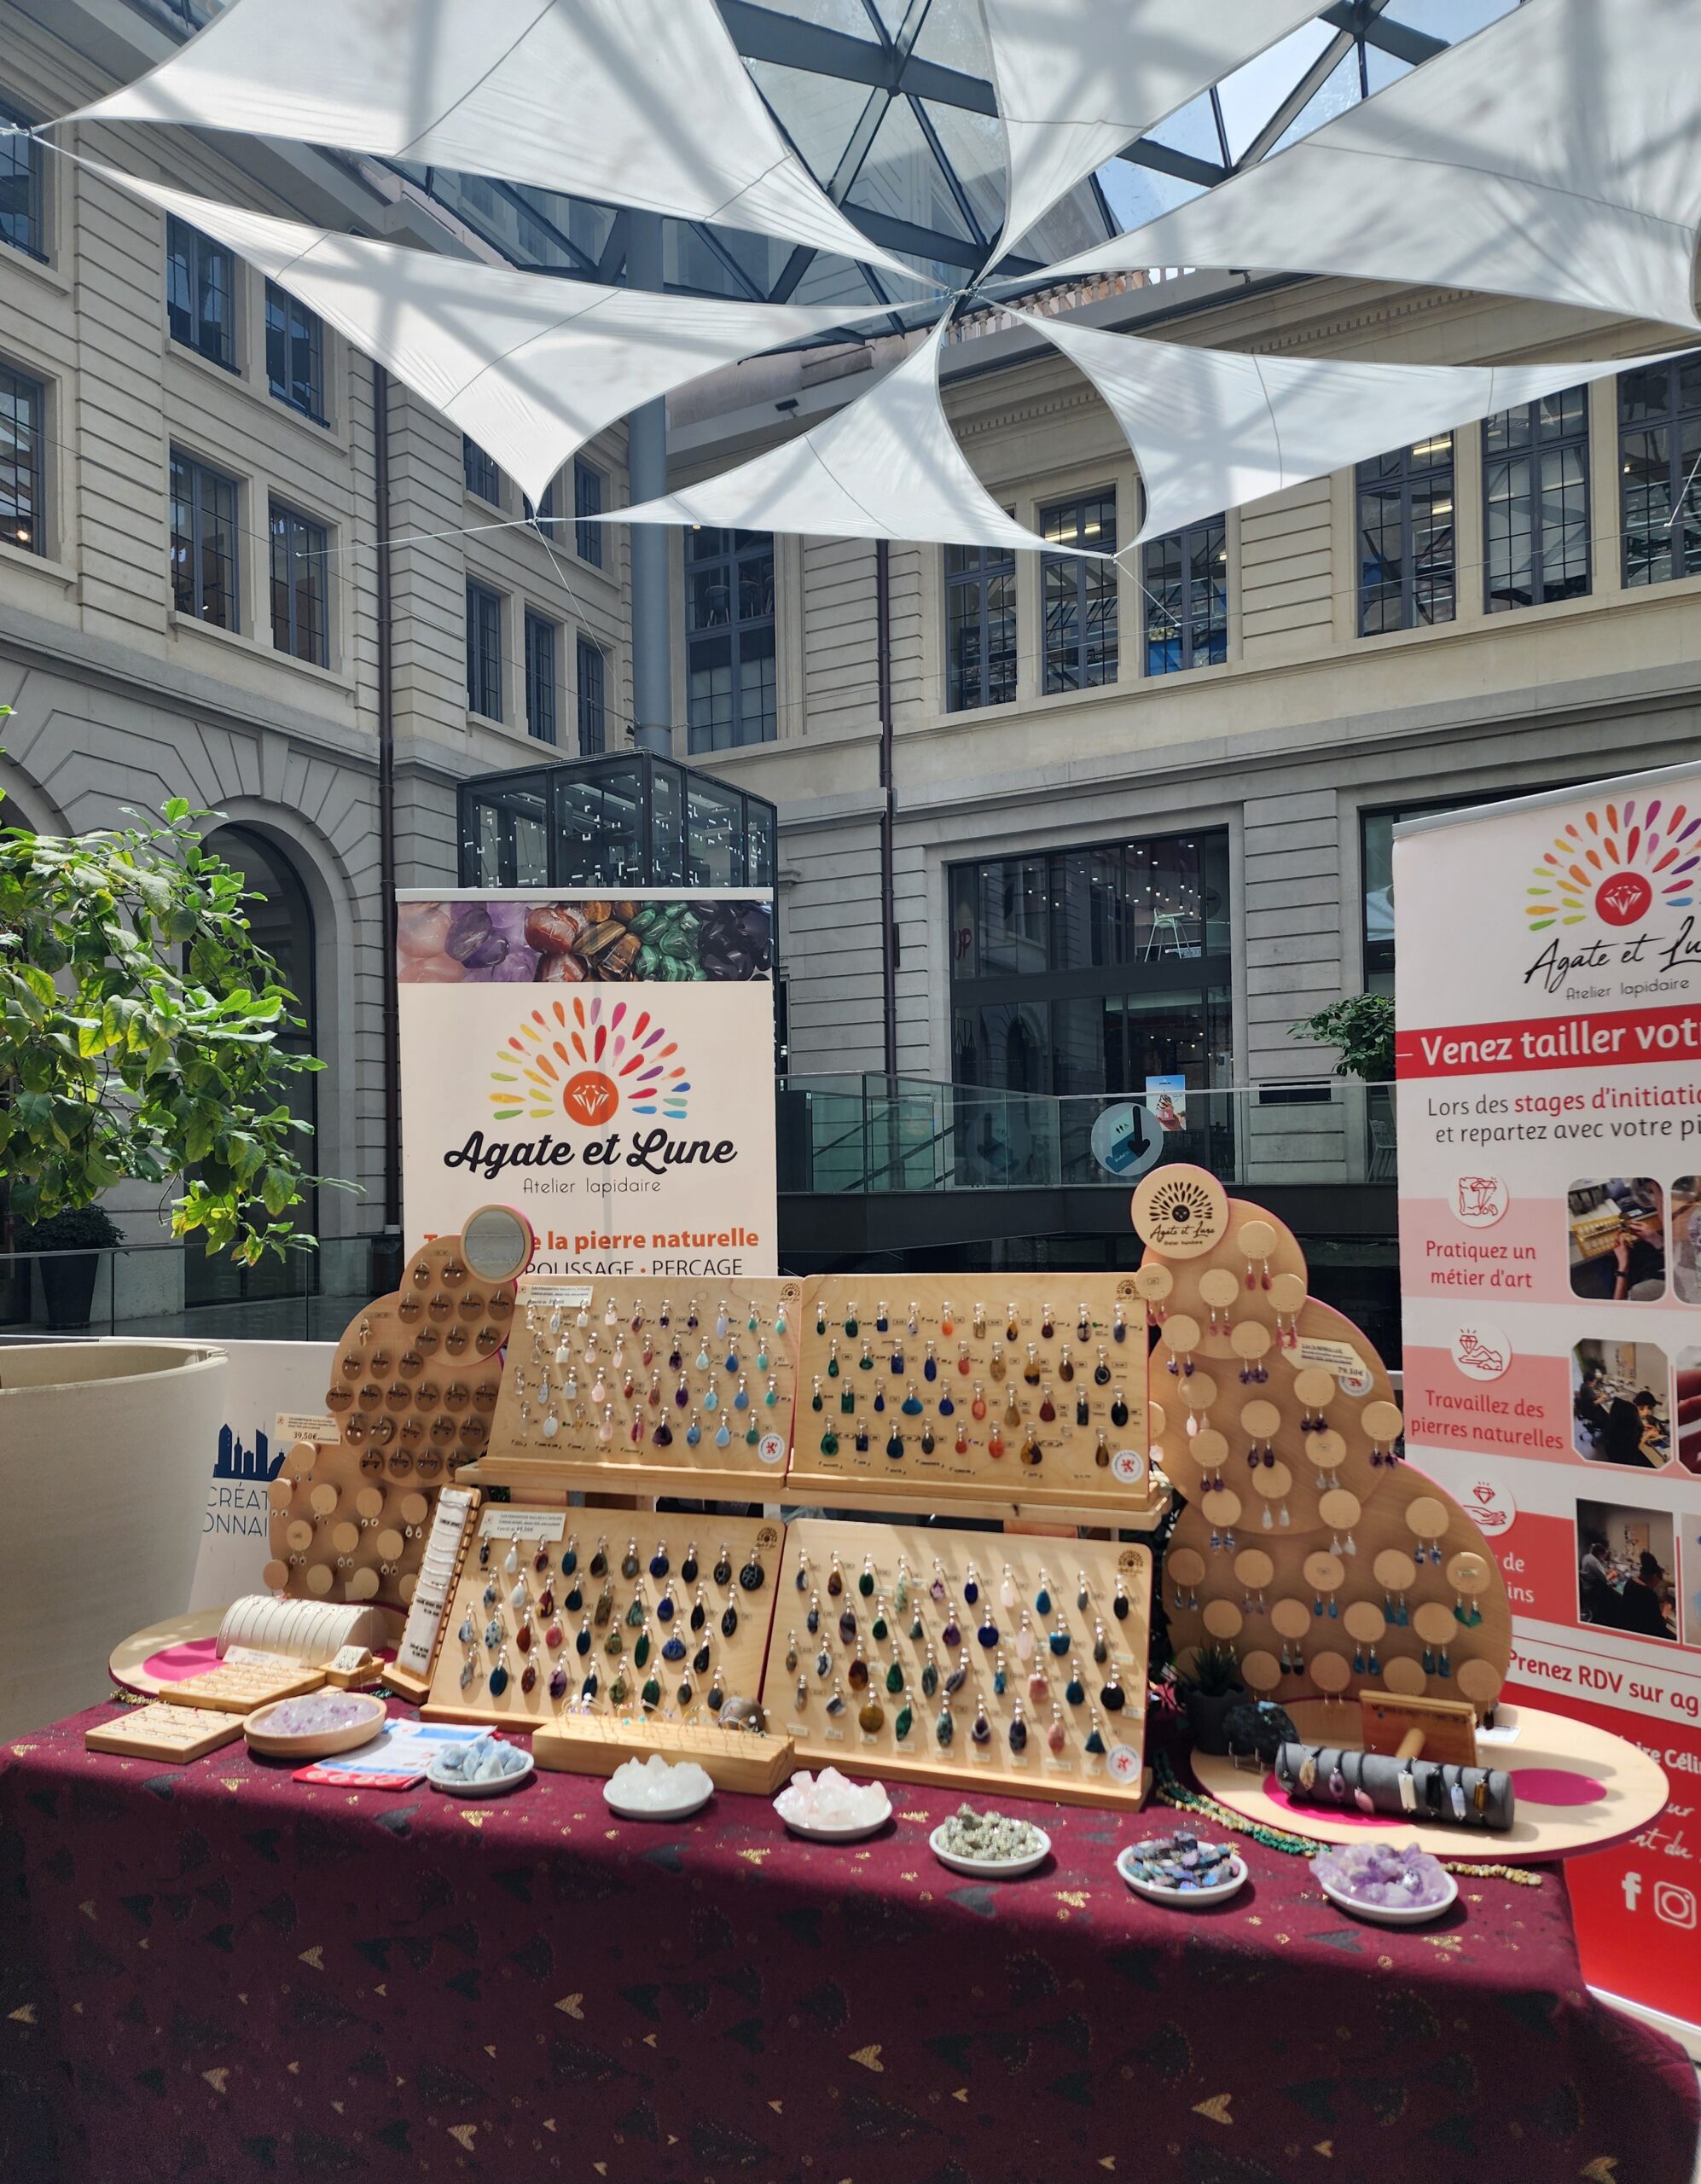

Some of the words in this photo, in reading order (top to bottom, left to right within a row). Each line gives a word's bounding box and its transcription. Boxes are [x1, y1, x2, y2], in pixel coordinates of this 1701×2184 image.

[1524, 938, 1619, 993] Agate
[1622, 933, 1665, 963] et
[1566, 986, 1611, 1000] Atelier
[1622, 979, 1689, 997] lapidaire
[1421, 1036, 1512, 1065] Venez
[1520, 1021, 1626, 1059] tailler
[1635, 1017, 1701, 1049] vot
[1429, 1099, 1469, 1116] Lors
[1476, 1095, 1508, 1114] des
[1514, 1091, 1585, 1118] stages
[1437, 1127, 1454, 1142] et
[1461, 1124, 1547, 1147] repartez
[1554, 1124, 1603, 1139] avec
[1611, 1119, 1672, 1136] votre
[444, 1130, 576, 1182] Agate
[583, 1134, 621, 1165] et
[626, 1129, 738, 1175] Lune
[524, 1178, 575, 1194] Atelier
[587, 1177, 660, 1198] lapidaire
[549, 1231, 567, 1250] la
[575, 1230, 646, 1254] pierre
[653, 1228, 758, 1248] naturelle
[1150, 1224, 1180, 1242] Agate
[1181, 1225, 1194, 1234] et
[1426, 1240, 1508, 1263] Pratiquez
[1513, 1247, 1536, 1259] un
[1431, 1269, 1485, 1286] métier
[1490, 1269, 1532, 1287] d'art
[1425, 1390, 1509, 1414] Travaillez
[1514, 1399, 1544, 1419] des
[1411, 1417, 1467, 1438] pierres
[1472, 1427, 1564, 1449] naturelles
[1502, 1552, 1525, 1573] de
[1507, 1581, 1535, 1604] ins
[1508, 1649, 1573, 1683] Prenez
[1578, 1664, 1623, 1694] RDV
[1628, 1682, 1663, 1704] sur
[1670, 1690, 1700, 1718] ag
[1664, 1749, 1701, 1775] Céli
